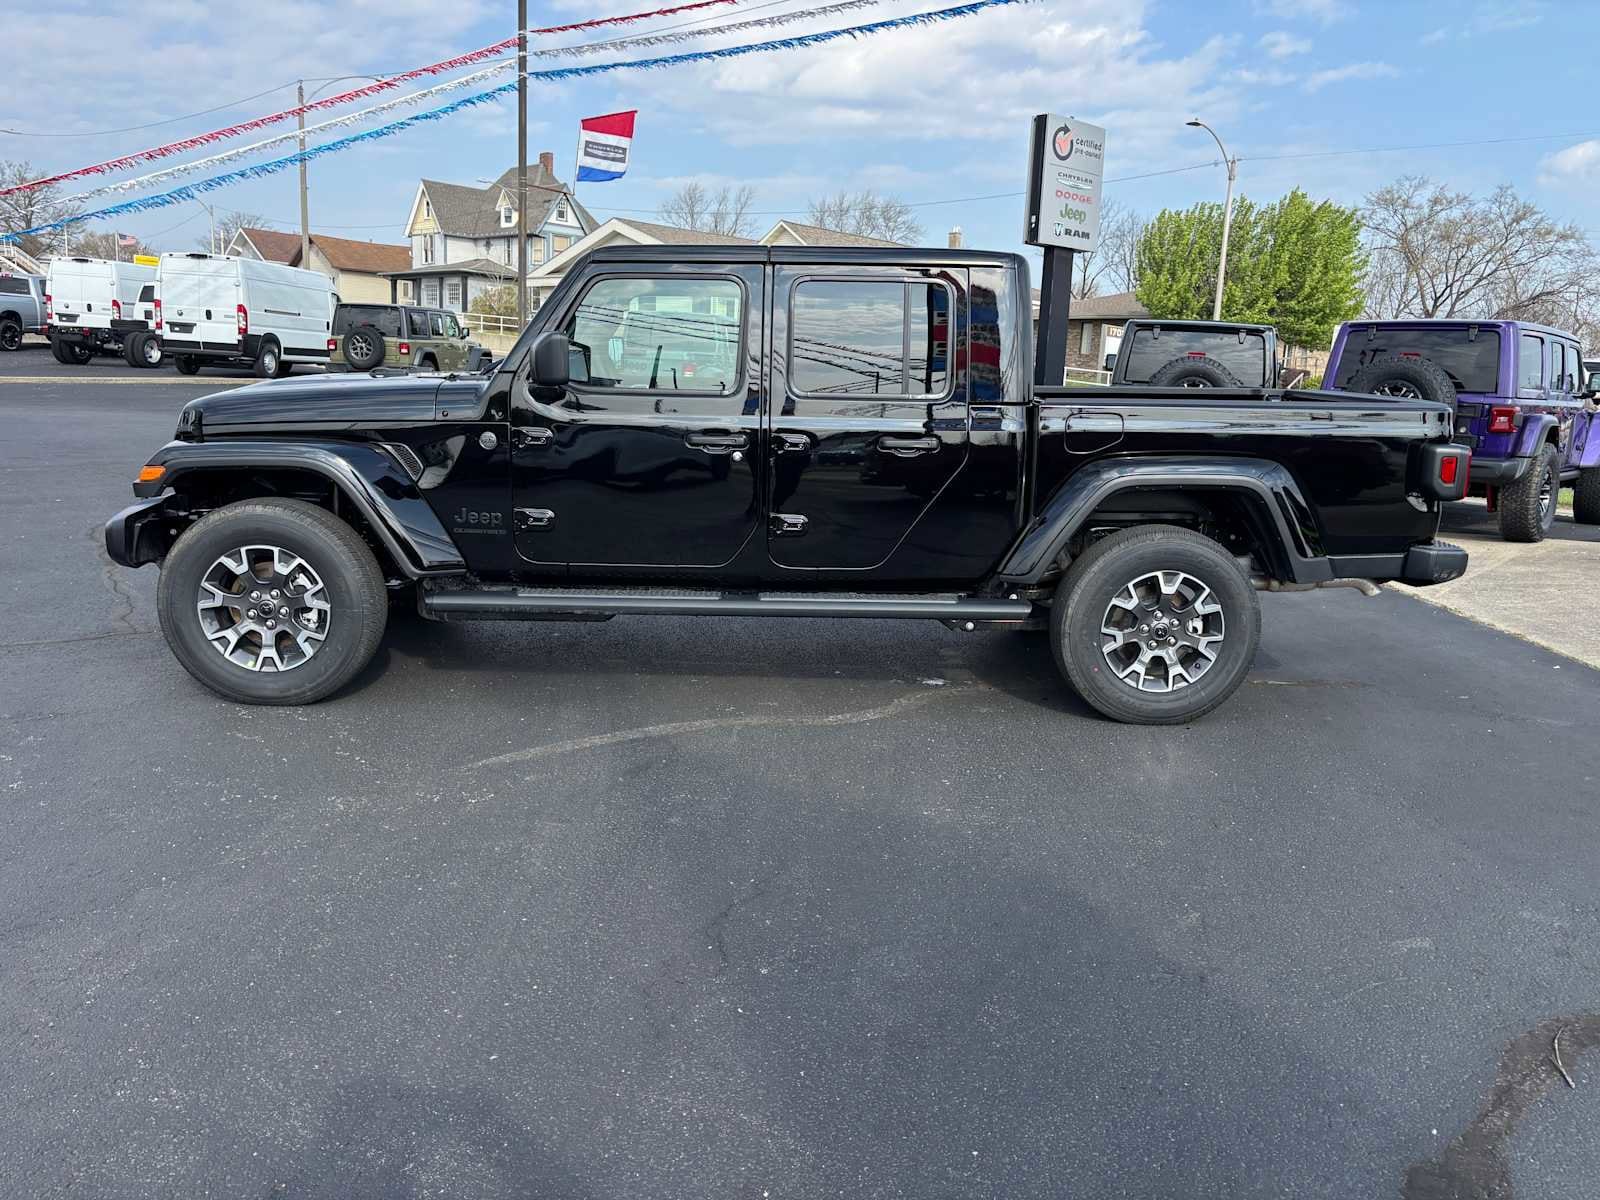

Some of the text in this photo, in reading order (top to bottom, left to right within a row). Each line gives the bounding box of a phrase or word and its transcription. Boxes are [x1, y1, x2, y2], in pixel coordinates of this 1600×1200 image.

[1075, 137, 1102, 151] certified
[1058, 171, 1093, 184] CHRYSLER
[1056, 190, 1093, 204] DODGE
[1060, 203, 1087, 224] Jeep
[1064, 228, 1091, 240] RAM
[453, 507, 503, 527] Jeep
